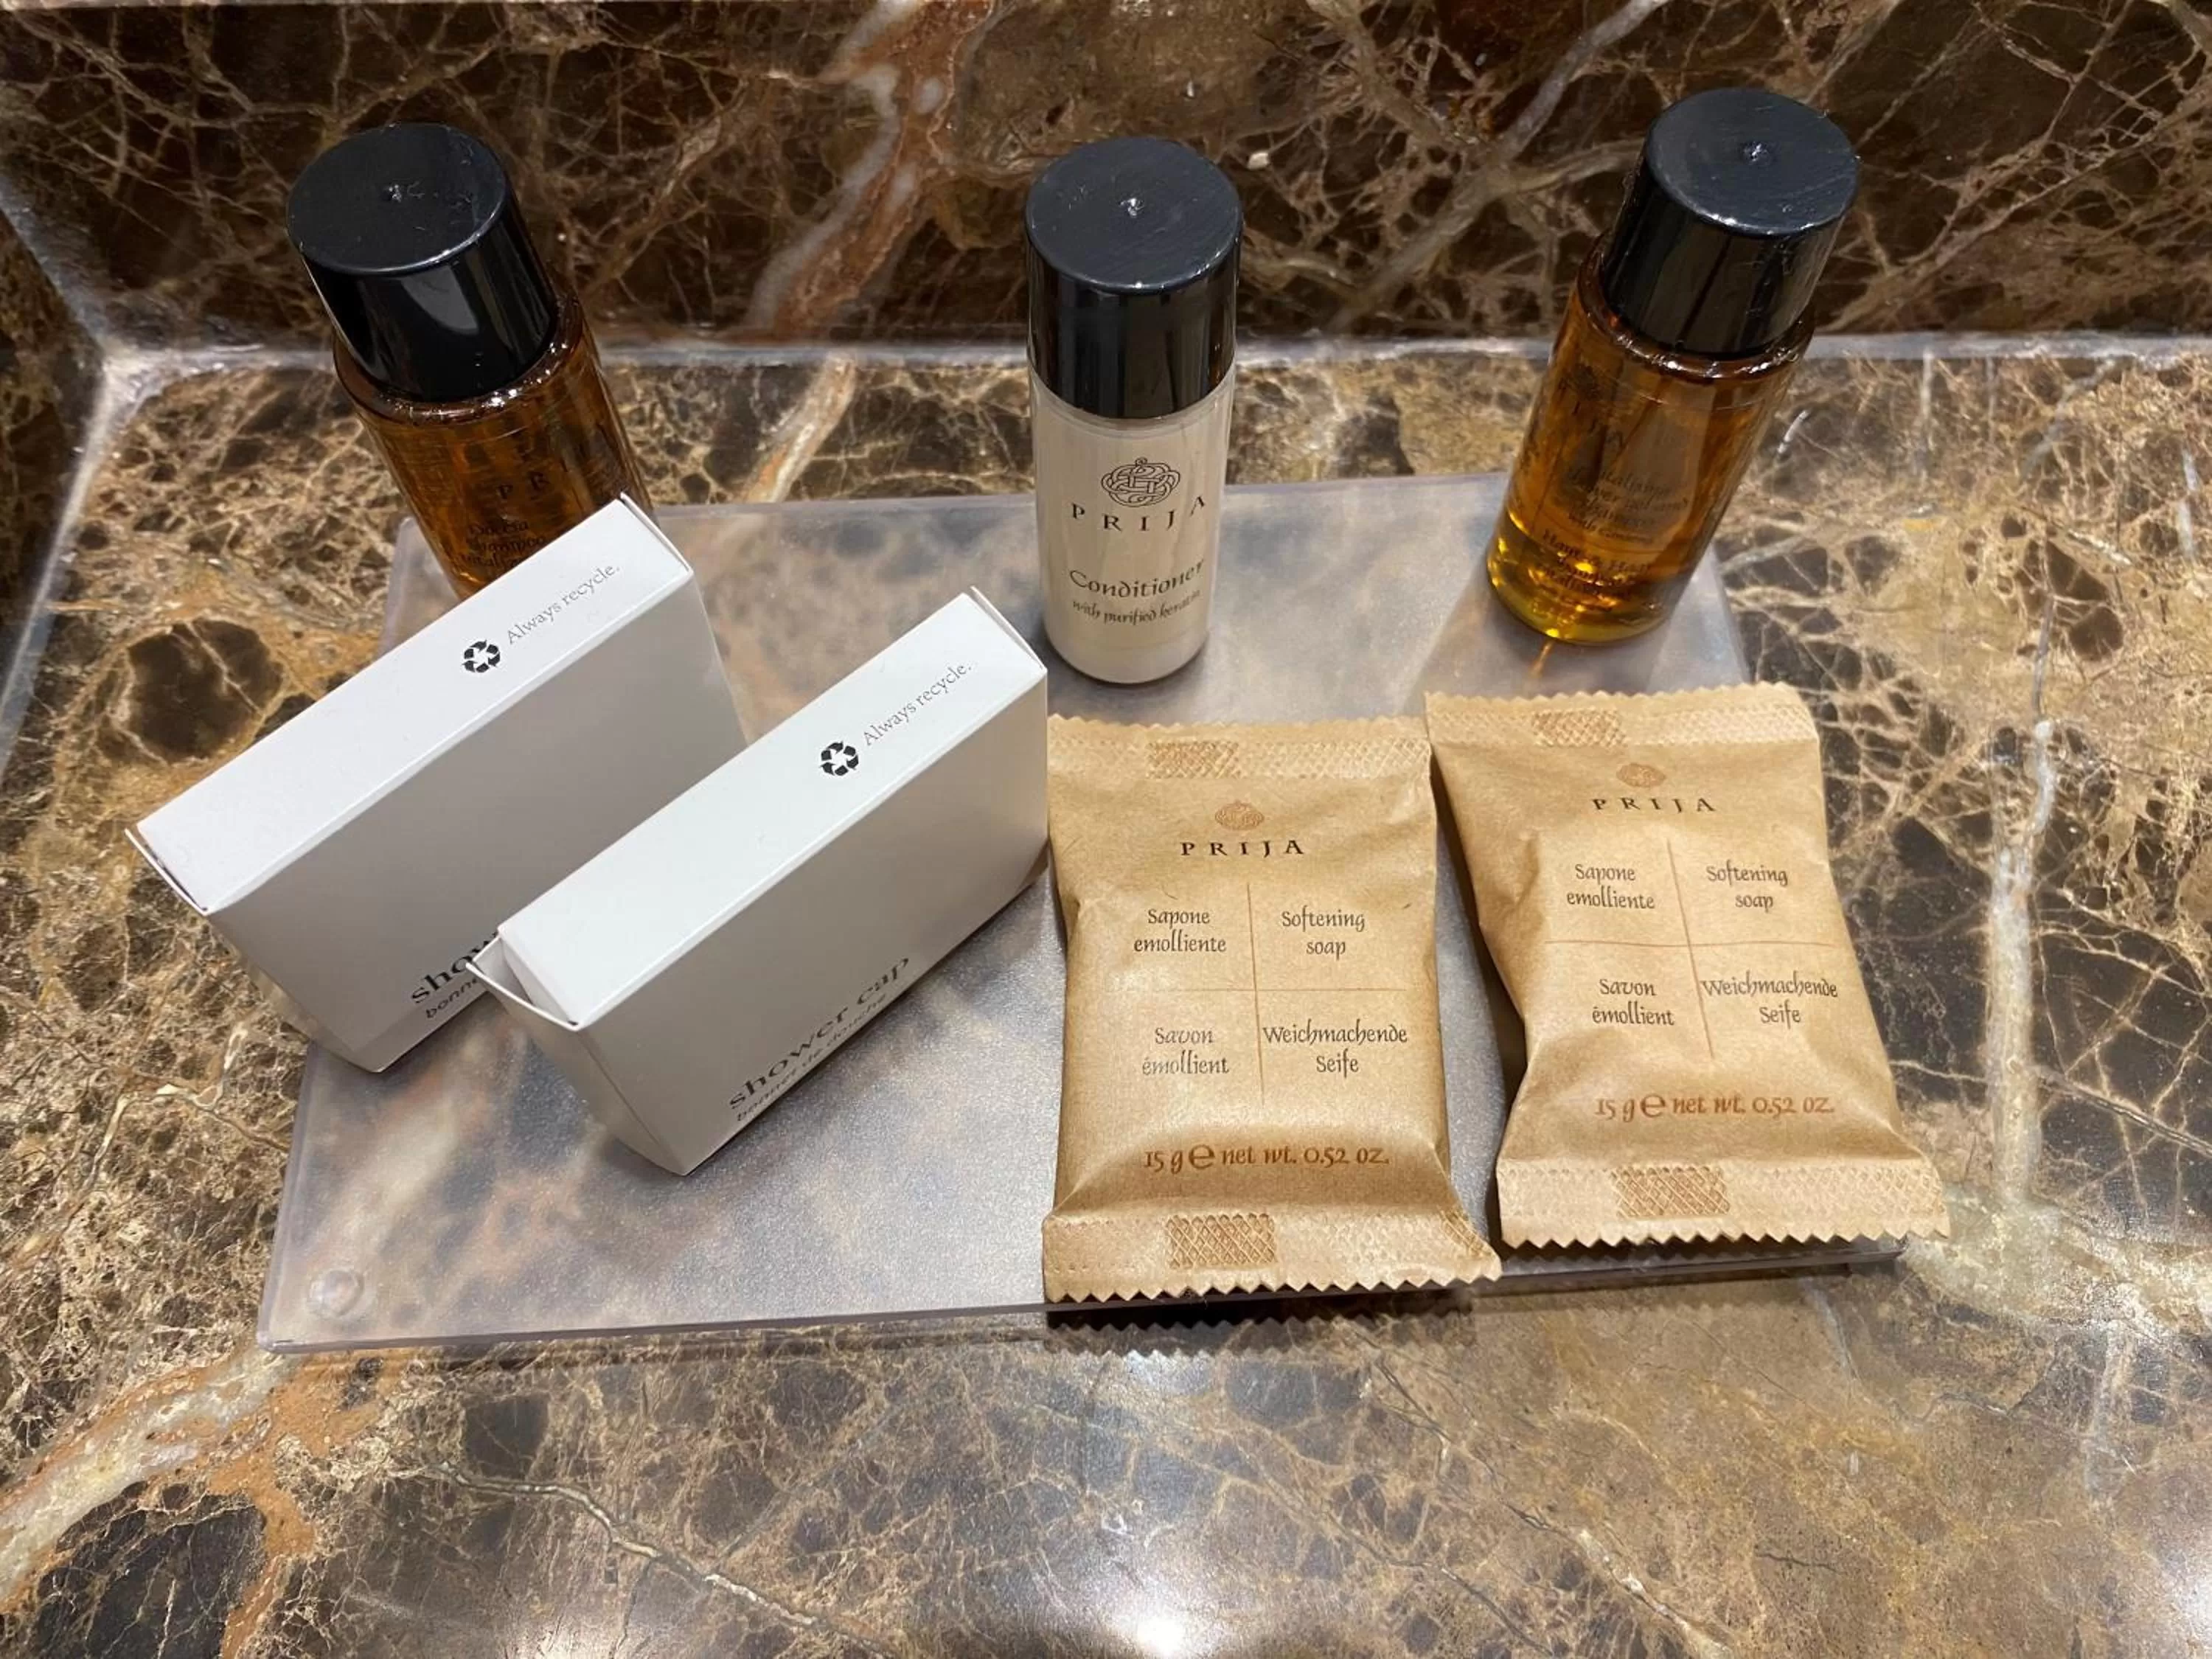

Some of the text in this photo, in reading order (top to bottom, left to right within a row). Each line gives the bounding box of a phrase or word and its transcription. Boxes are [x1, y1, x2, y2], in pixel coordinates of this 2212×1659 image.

[1071, 495, 1206, 532] PRIJA
[1069, 558, 1205, 598] Conditioner
[507, 564, 620, 644] Always recycle.
[1073, 600, 1101, 618] with
[1104, 608, 1157, 626] purified
[863, 662, 973, 746] Always recycle.
[1592, 797, 1717, 813] PRIJA
[1180, 839, 1304, 858] PRIJA
[1575, 863, 1636, 884] Sapone
[1706, 859, 1788, 886] Softening
[1567, 886, 1655, 909] emolliente
[1735, 893, 1774, 914] soap
[1147, 908, 1211, 930] Sapone
[1281, 905, 1366, 932] Softening
[1133, 929, 1227, 953] emolliente
[1306, 939, 1346, 960] soap
[1599, 978, 1658, 997] Savon
[1703, 970, 1839, 998] Weichmachende
[1592, 1001, 1675, 1026] émollient
[1759, 999, 1801, 1030] Seife
[729, 958, 909, 1109] shower cap
[1155, 1026, 1215, 1045] Savon
[1262, 1018, 1408, 1044] Weichmachende
[1141, 1049, 1230, 1074] émollient
[1315, 1048, 1360, 1079] Seife
[1672, 1093, 1708, 1115] net
[1714, 1093, 1747, 1115] wt.
[1752, 1096, 1797, 1120] 0.52
[1803, 1097, 1836, 1115] oz.
[1222, 1147, 1255, 1165] net
[1263, 1147, 1298, 1165] wt.
[1303, 1147, 1349, 1169] 0.52
[1356, 1149, 1390, 1165] oz.
